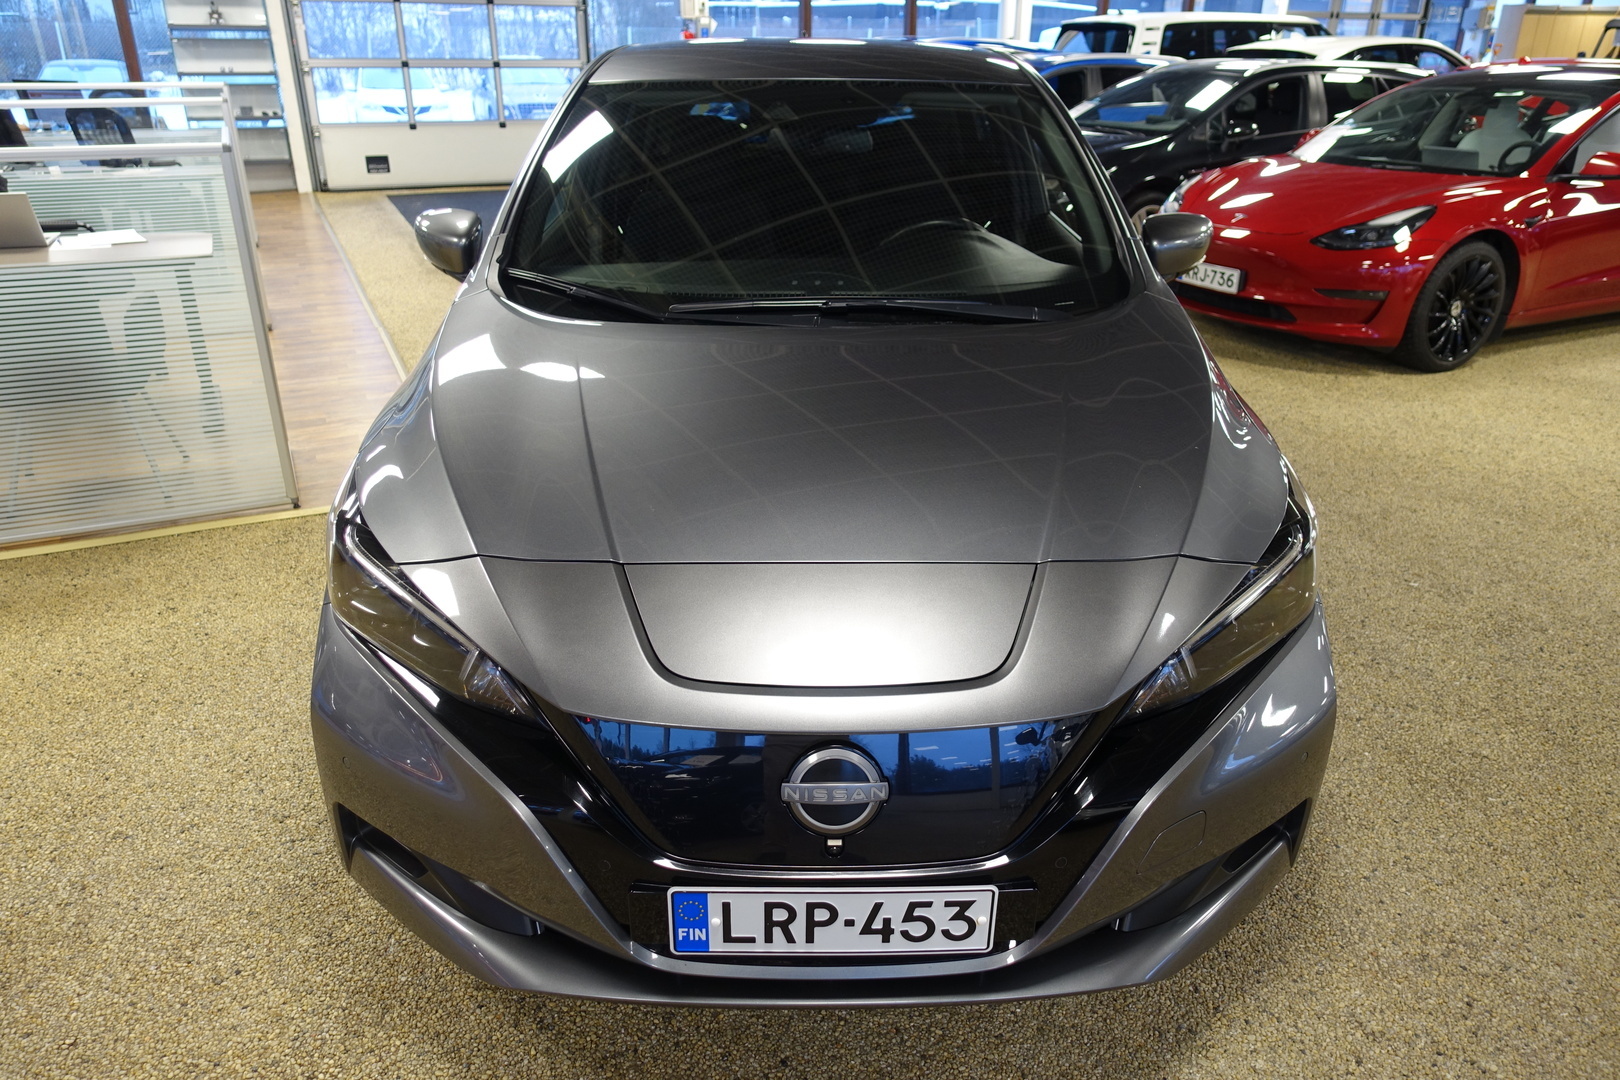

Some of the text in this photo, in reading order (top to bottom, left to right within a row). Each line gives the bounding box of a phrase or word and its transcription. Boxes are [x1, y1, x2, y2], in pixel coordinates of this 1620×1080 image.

[783, 786, 887, 802] NISSAN
[721, 899, 978, 944] LRP-453
[677, 927, 707, 941] FIN
